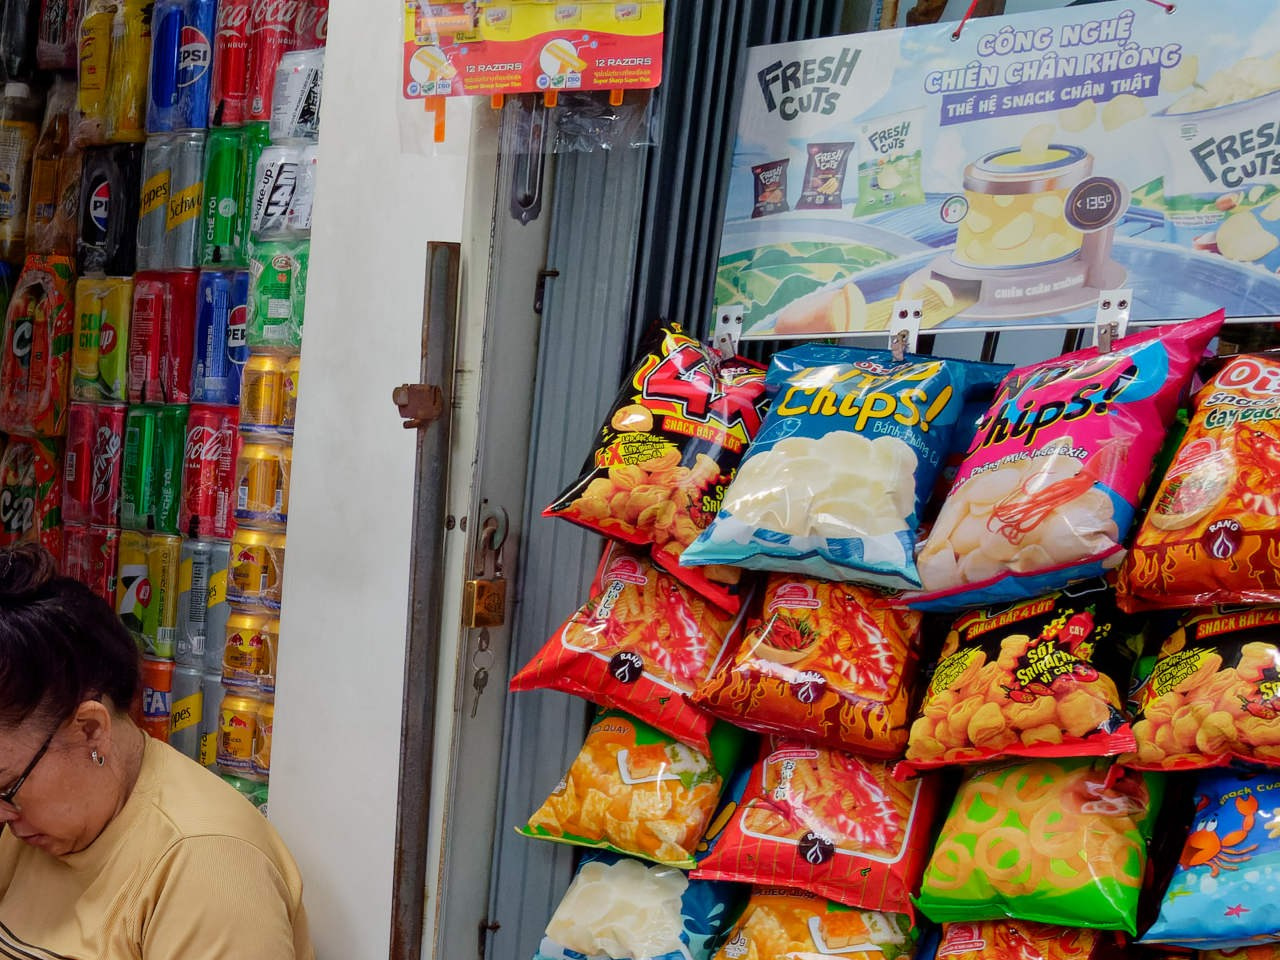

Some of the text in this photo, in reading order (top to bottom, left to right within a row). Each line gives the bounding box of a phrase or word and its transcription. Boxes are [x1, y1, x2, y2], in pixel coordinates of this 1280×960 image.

[977, 9, 1136, 57] CÔNG NGHỆ
[478, 63, 522, 72] RAZORS
[608, 58, 652, 66] RAZORS
[924, 42, 1182, 95] CHIÊN CHÂN KHÔNG
[757, 47, 862, 114] FRESH
[779, 85, 841, 122] CUTS
[947, 74, 1153, 118] THẾ HỆ SNACK CHÂN THẬT
[869, 121, 911, 153] FRESH
[873, 135, 906, 155] CUTS
[815, 149, 844, 168] FRESH
[758, 167, 782, 183] FRESH
[777, 384, 953, 432] Chips!
[664, 419, 694, 435] SNACK
[874, 422, 899, 435] Bánh
[1205, 407, 1238, 432] Cay
[1208, 519, 1239, 533] RANG
[968, 620, 998, 639] SNACK
[1069, 626, 1084, 636] CAY
[1198, 618, 1239, 637] SNACK
[620, 652, 642, 669] RANG
[1027, 640, 1056, 663] SỐT
[1055, 664, 1073, 675] cay
